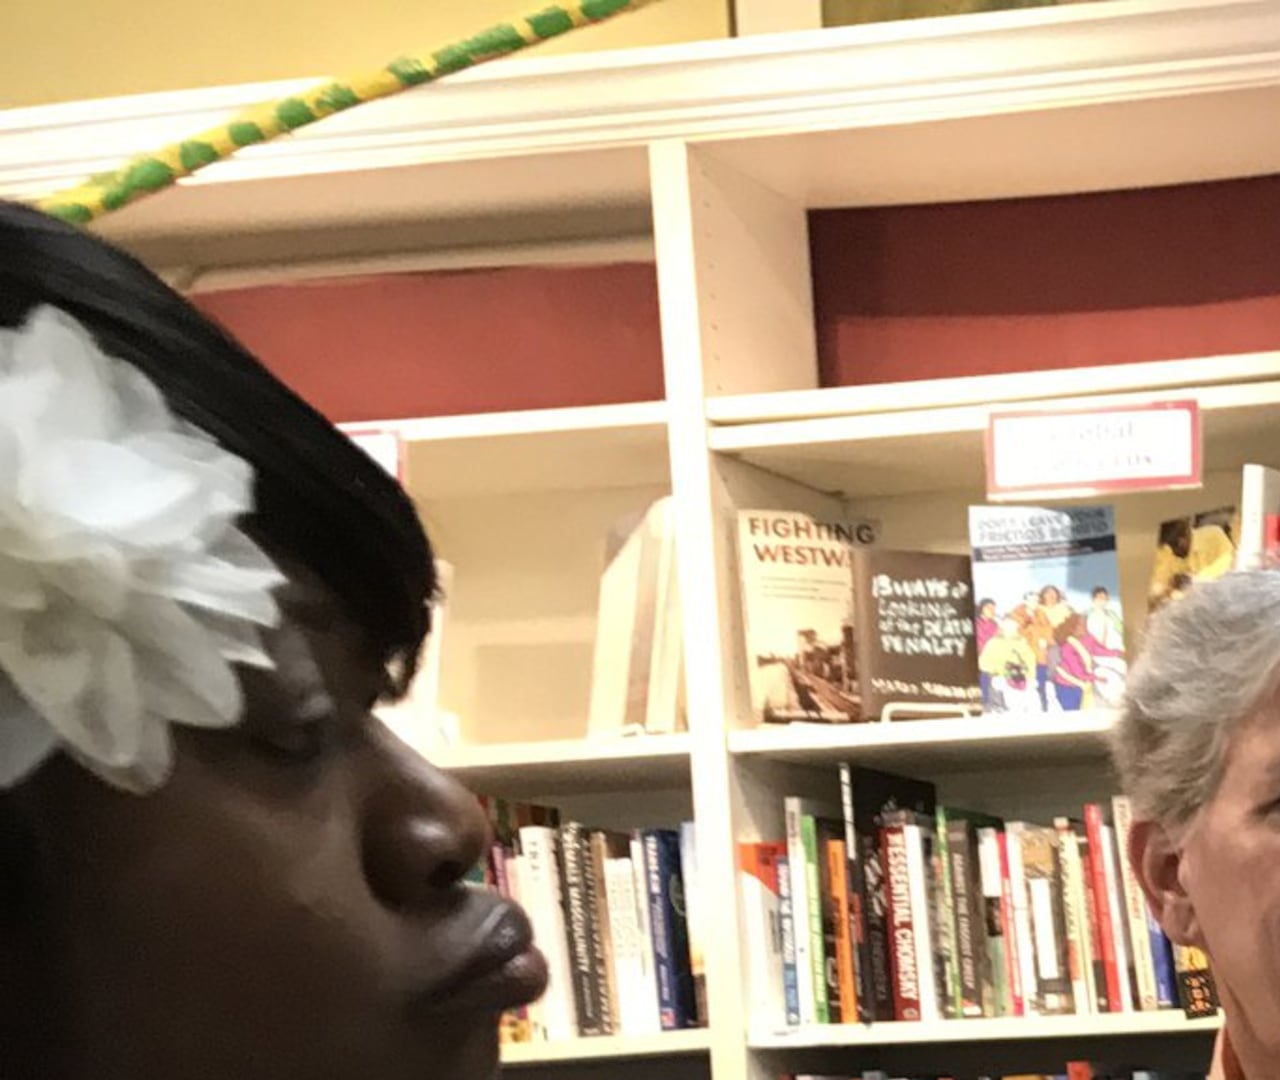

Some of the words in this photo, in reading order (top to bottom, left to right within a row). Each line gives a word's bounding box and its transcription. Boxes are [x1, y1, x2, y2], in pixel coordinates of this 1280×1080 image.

[748, 517, 876, 545] FIGHTING
[753, 544, 850, 569] WESTW
[887, 847, 911, 927] ESSENTIAL
[895, 928, 919, 1001] CHOMSKY
